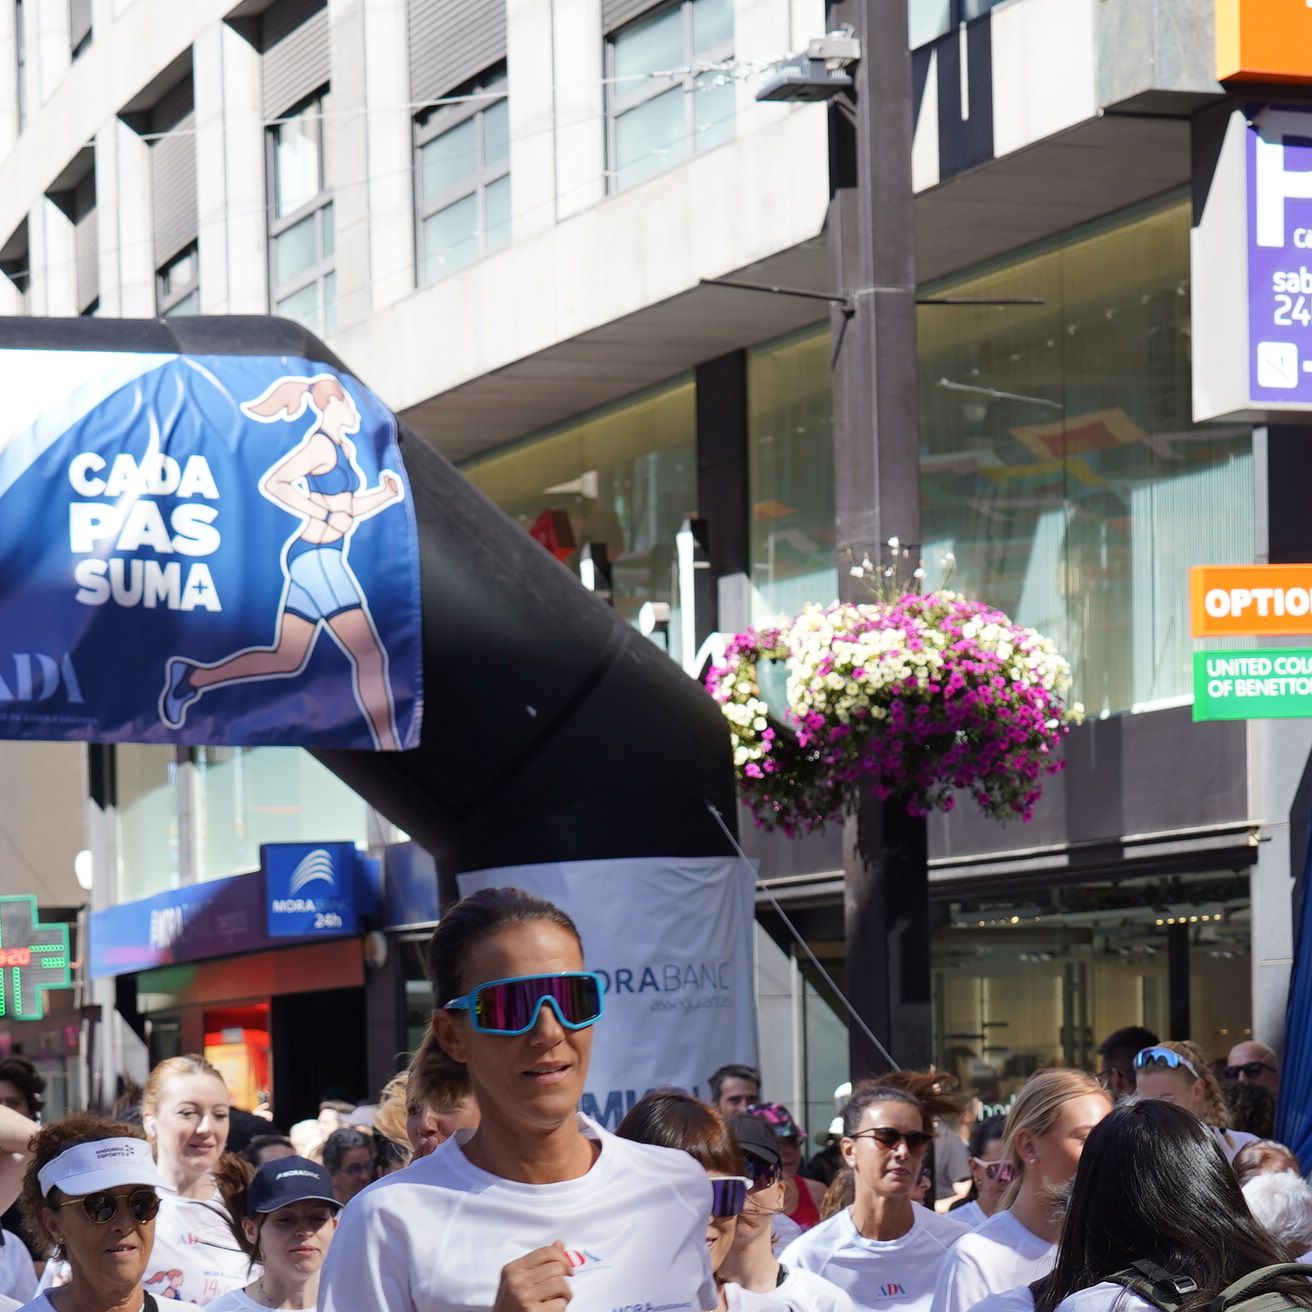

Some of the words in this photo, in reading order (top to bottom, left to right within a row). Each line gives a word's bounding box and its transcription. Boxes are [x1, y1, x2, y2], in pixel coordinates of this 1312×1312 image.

[68, 452, 221, 499] CADA
[69, 500, 222, 556] PAS
[74, 558, 223, 612] SUMA
[1206, 657, 1272, 678] UNITED
[1208, 680, 1232, 698] OF
[593, 961, 730, 993] ORABANC
[563, 1249, 603, 1267] DA
